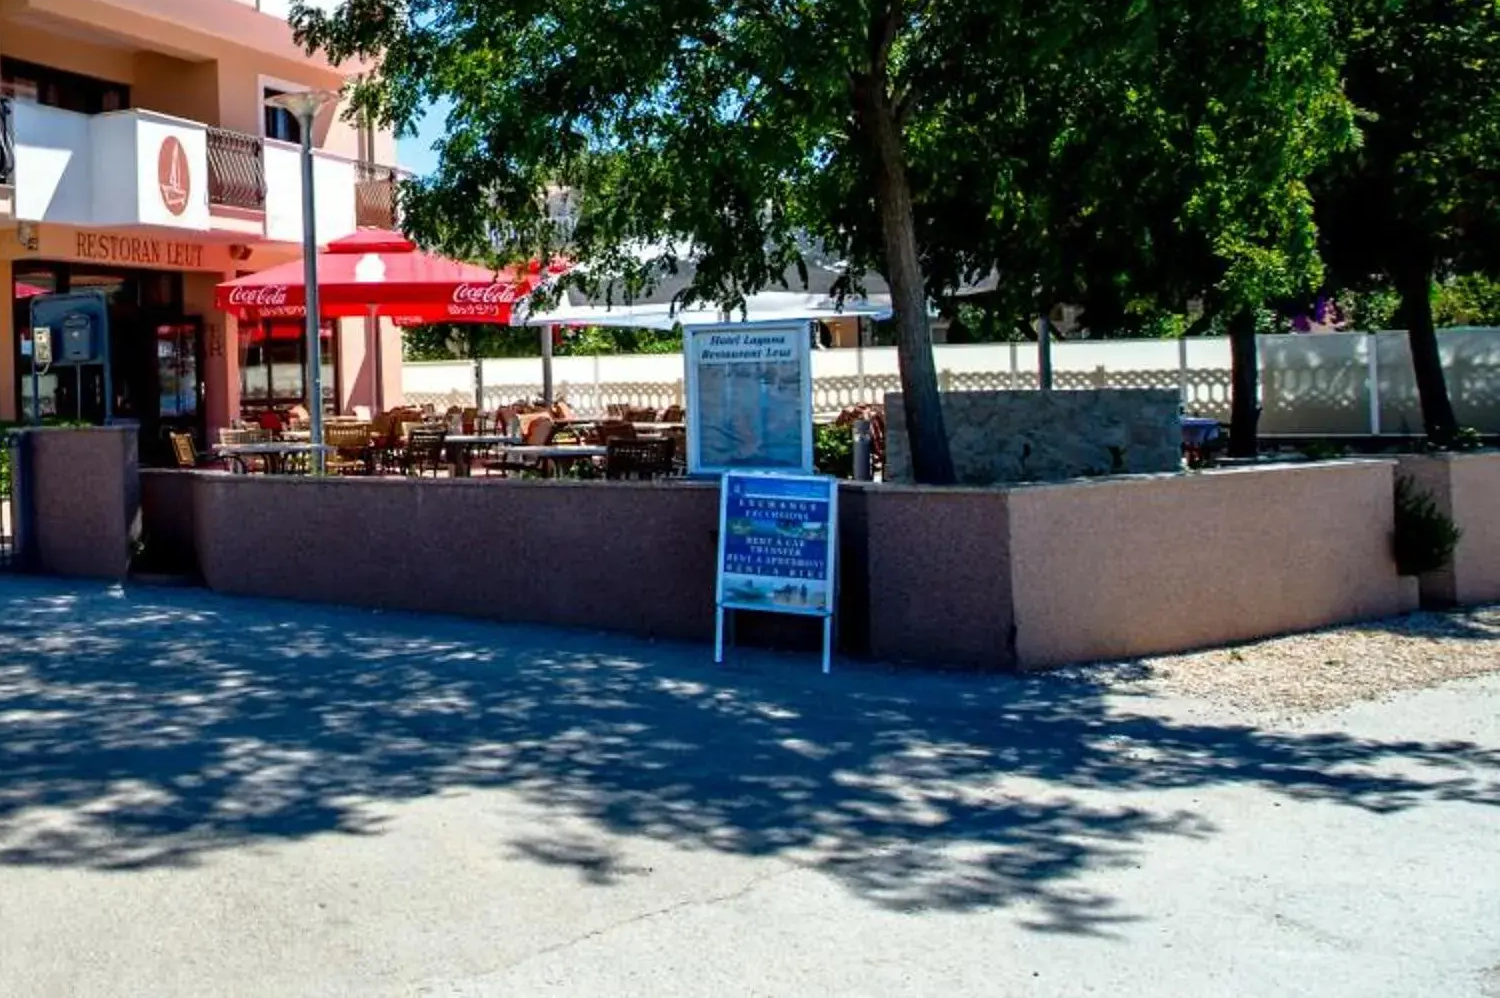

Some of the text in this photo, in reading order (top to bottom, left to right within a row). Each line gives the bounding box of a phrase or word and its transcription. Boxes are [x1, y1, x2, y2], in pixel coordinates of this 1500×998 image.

[76, 231, 203, 267] RESTORAN LEUT
[710, 334, 785, 346] Hotel Laguna
[701, 349, 761, 359] Restaurant
[746, 537, 772, 545] RENT
